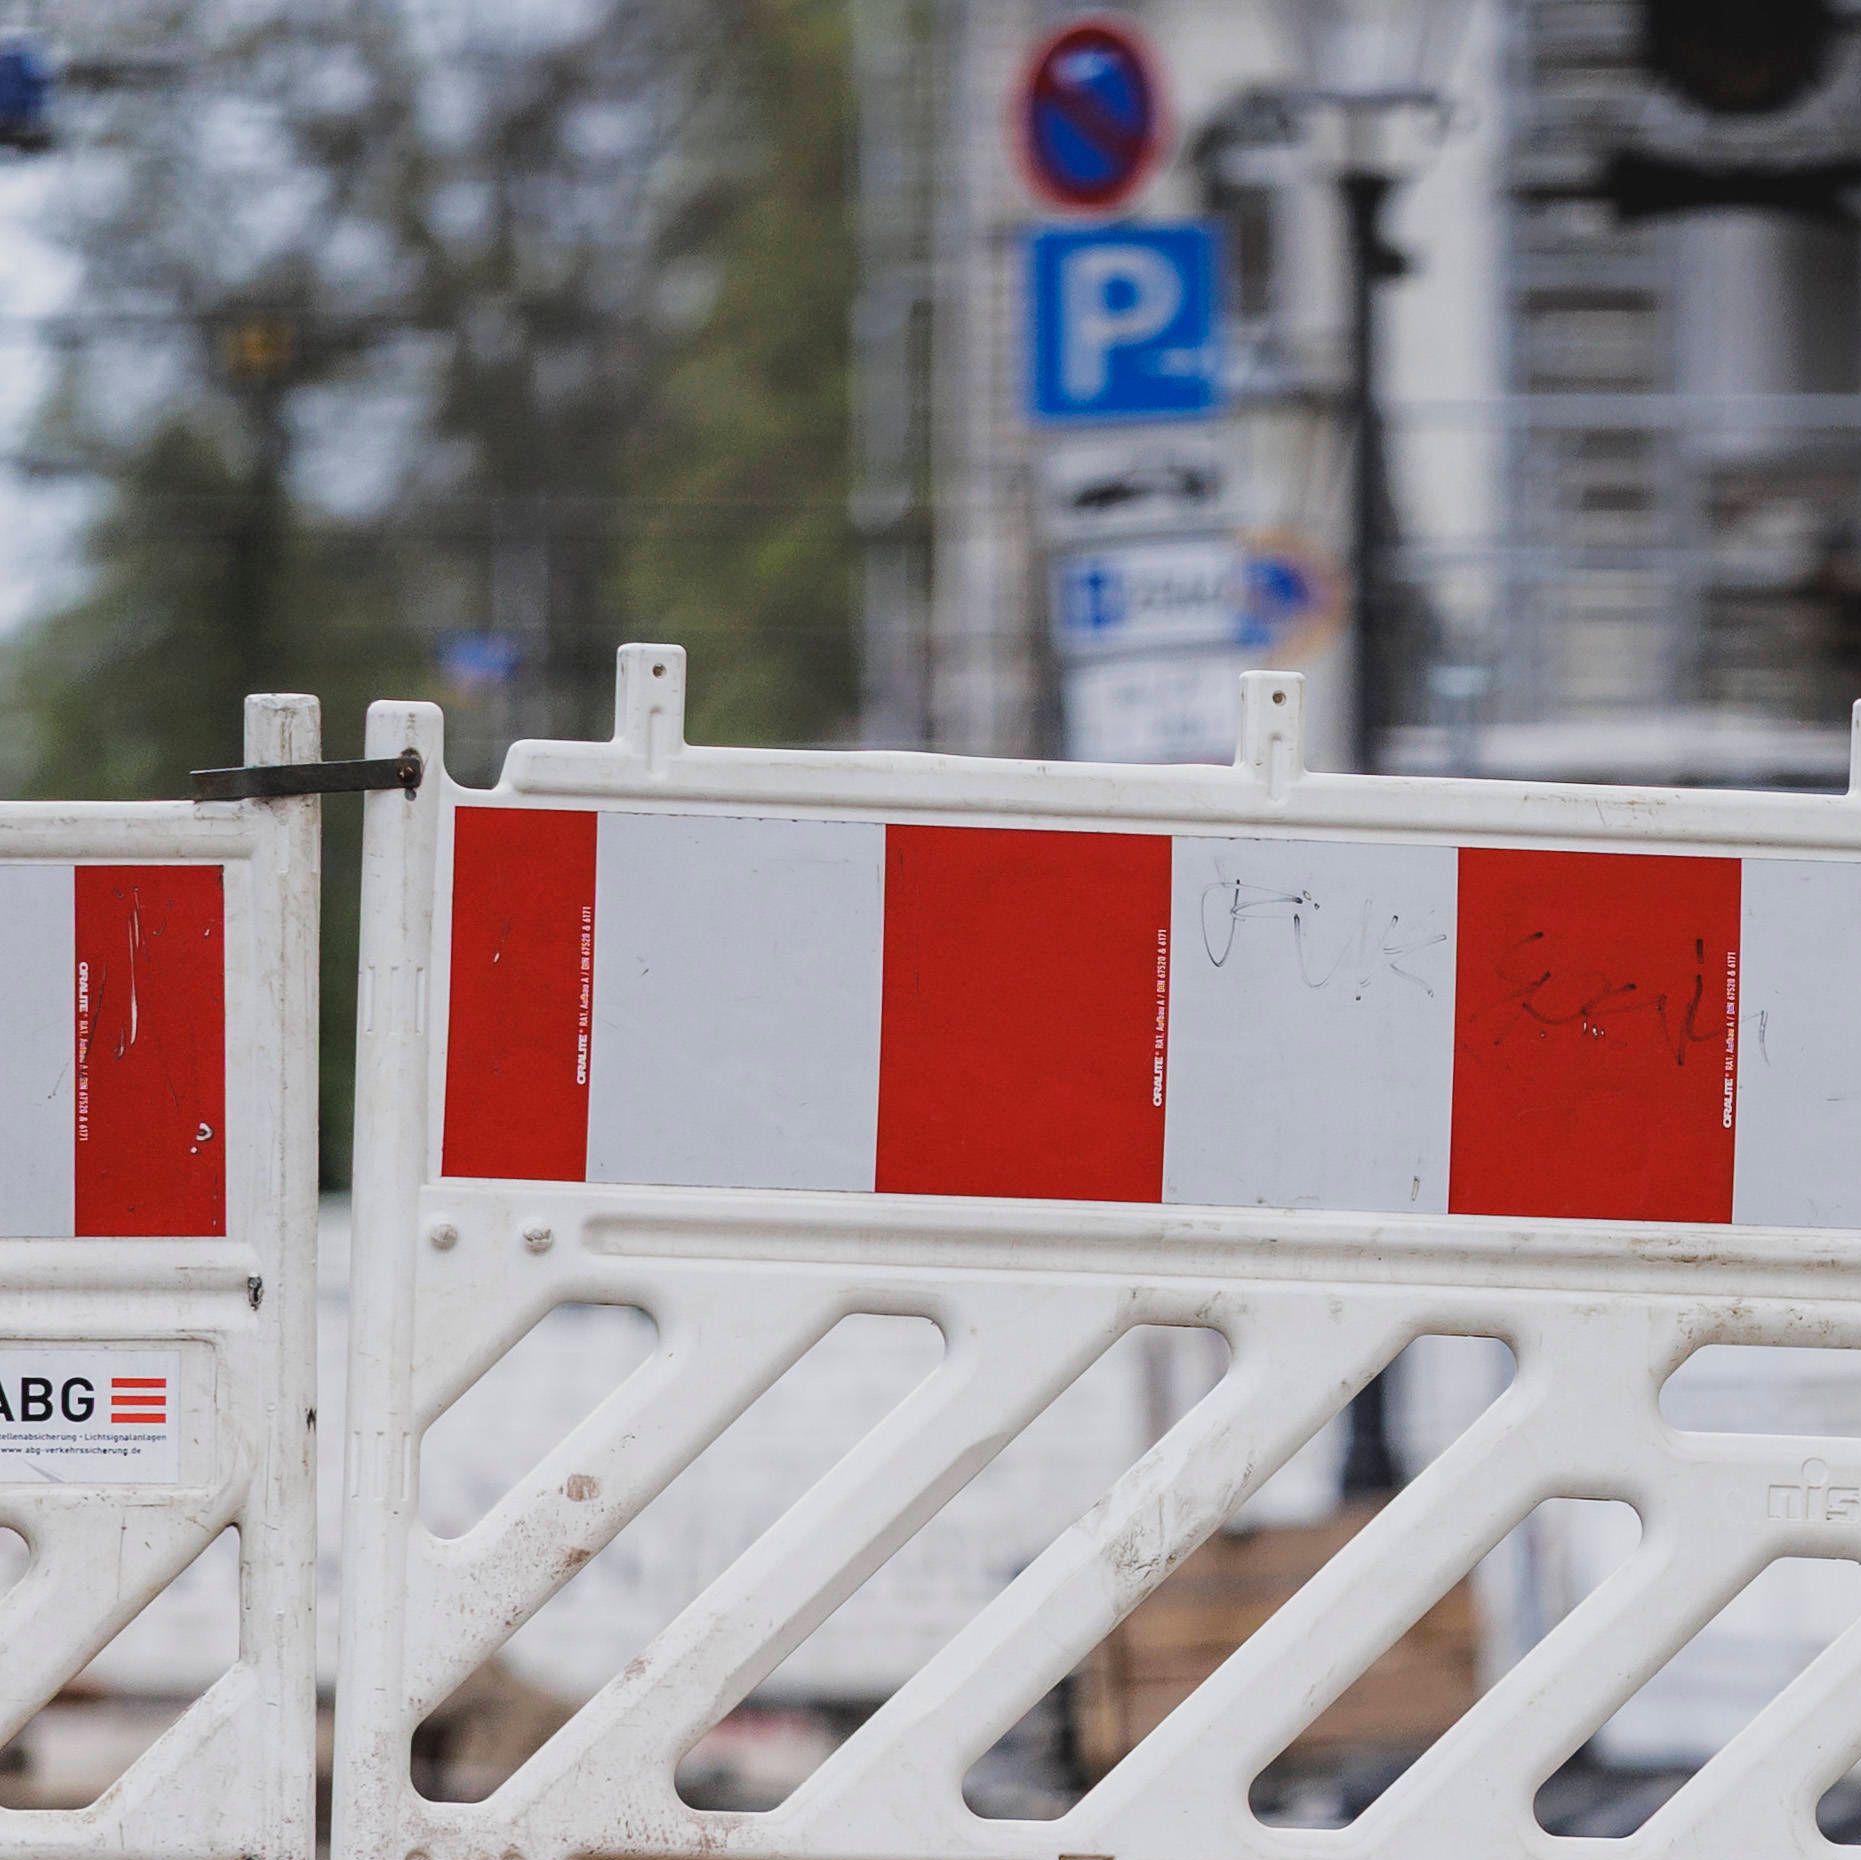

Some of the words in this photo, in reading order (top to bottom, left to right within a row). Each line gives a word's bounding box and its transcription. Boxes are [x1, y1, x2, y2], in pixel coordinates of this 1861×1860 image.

[1059, 243, 1187, 403] P
[581, 906, 592, 923] 6171
[581, 924, 591, 932] &
[580, 932, 591, 957] 67520
[1157, 929, 1167, 946] 6171
[1157, 947, 1167, 955] &
[1156, 955, 1167, 979] 67520
[1726, 951, 1737, 969] 6171
[1726, 969, 1737, 977] &
[1726, 977, 1736, 1001] 67520
[78, 1124, 89, 1141] 6171
[84, 1432, 167, 1443] Lichtsignalanlagen
